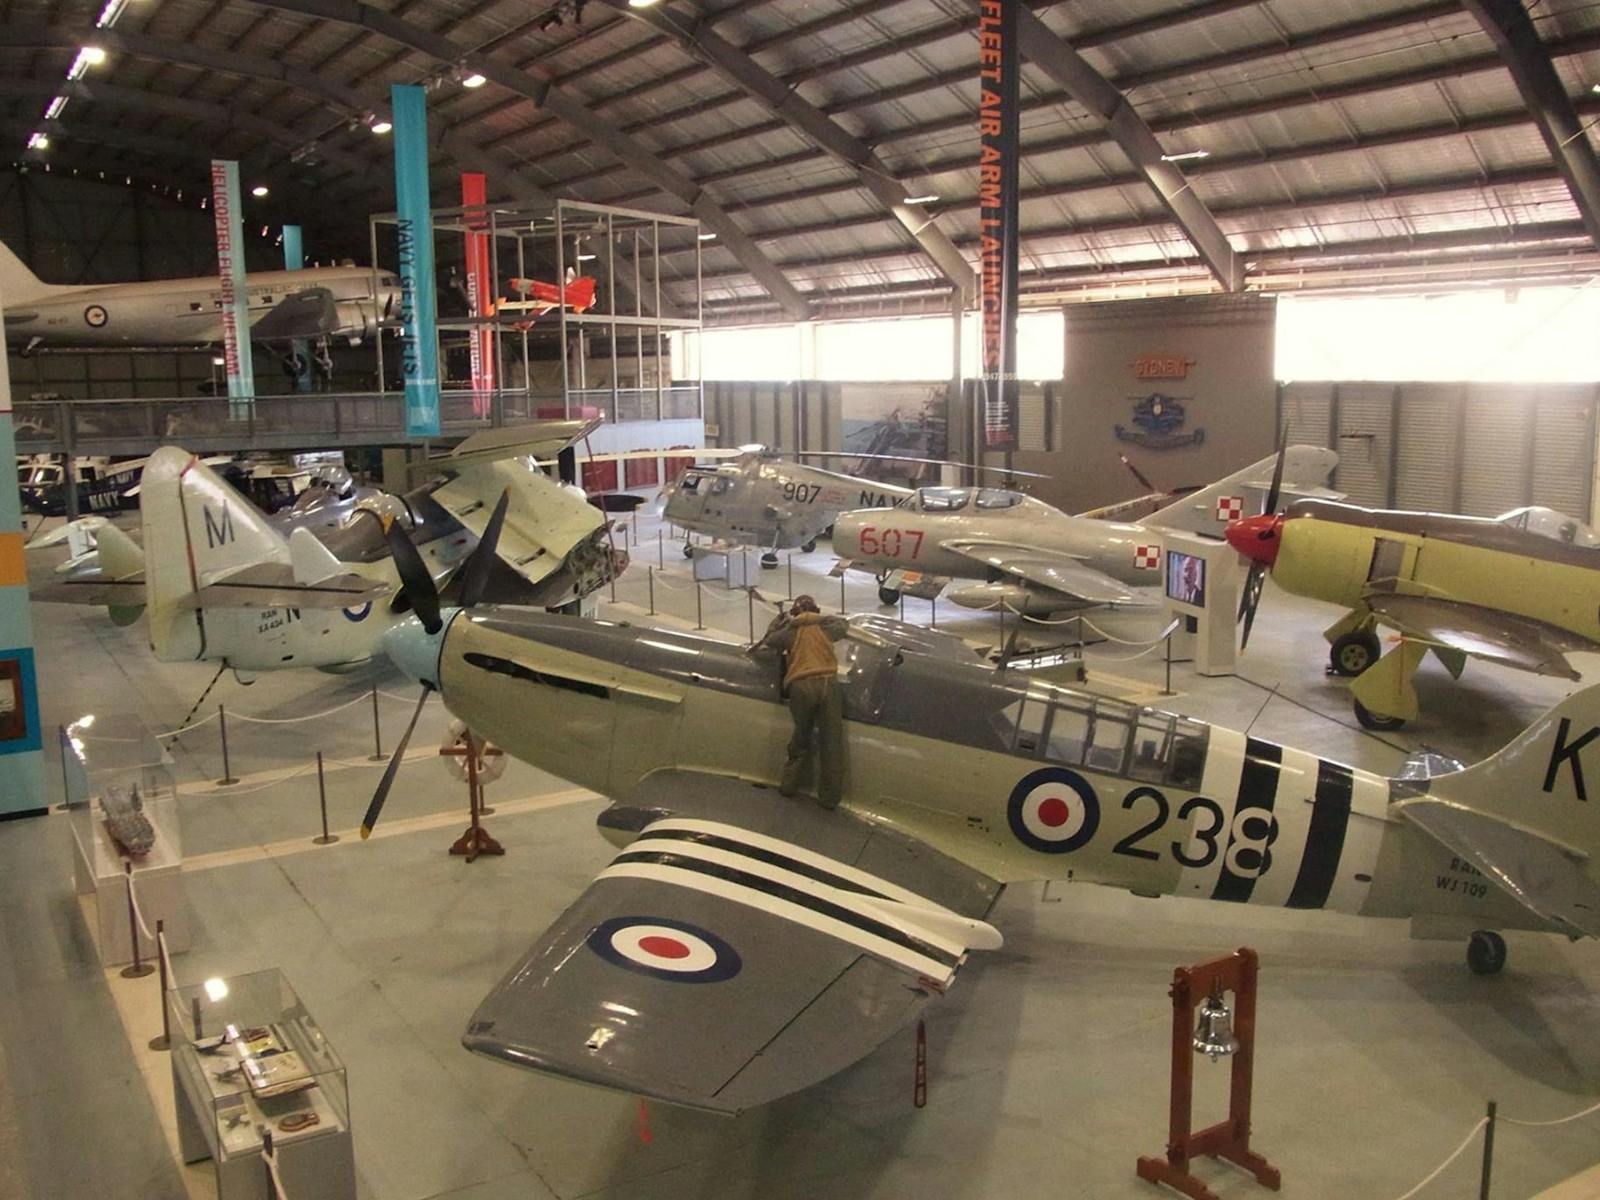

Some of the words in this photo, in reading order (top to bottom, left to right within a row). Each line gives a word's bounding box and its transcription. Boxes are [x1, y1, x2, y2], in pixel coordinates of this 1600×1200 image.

[980, 0, 1002, 84] FLEET
[980, 88, 1001, 136] AIR
[980, 144, 1001, 207] ARM
[211, 164, 230, 251] HELICOPTER
[397, 219, 416, 269] NAVY
[219, 257, 235, 304] FLIGHT
[401, 276, 415, 325] GETS
[980, 218, 1001, 370] LAUNCHES
[223, 311, 239, 376] VIETNAM
[401, 335, 418, 374] JETS
[88, 489, 119, 511] NAVY
[782, 482, 822, 505] 907
[203, 498, 235, 549] M
[860, 526, 924, 560] 607
[1542, 716, 1600, 803] K
[1112, 786, 1279, 879] 238
[1436, 875, 1458, 891] WJ
[1463, 881, 1487, 898] 109
